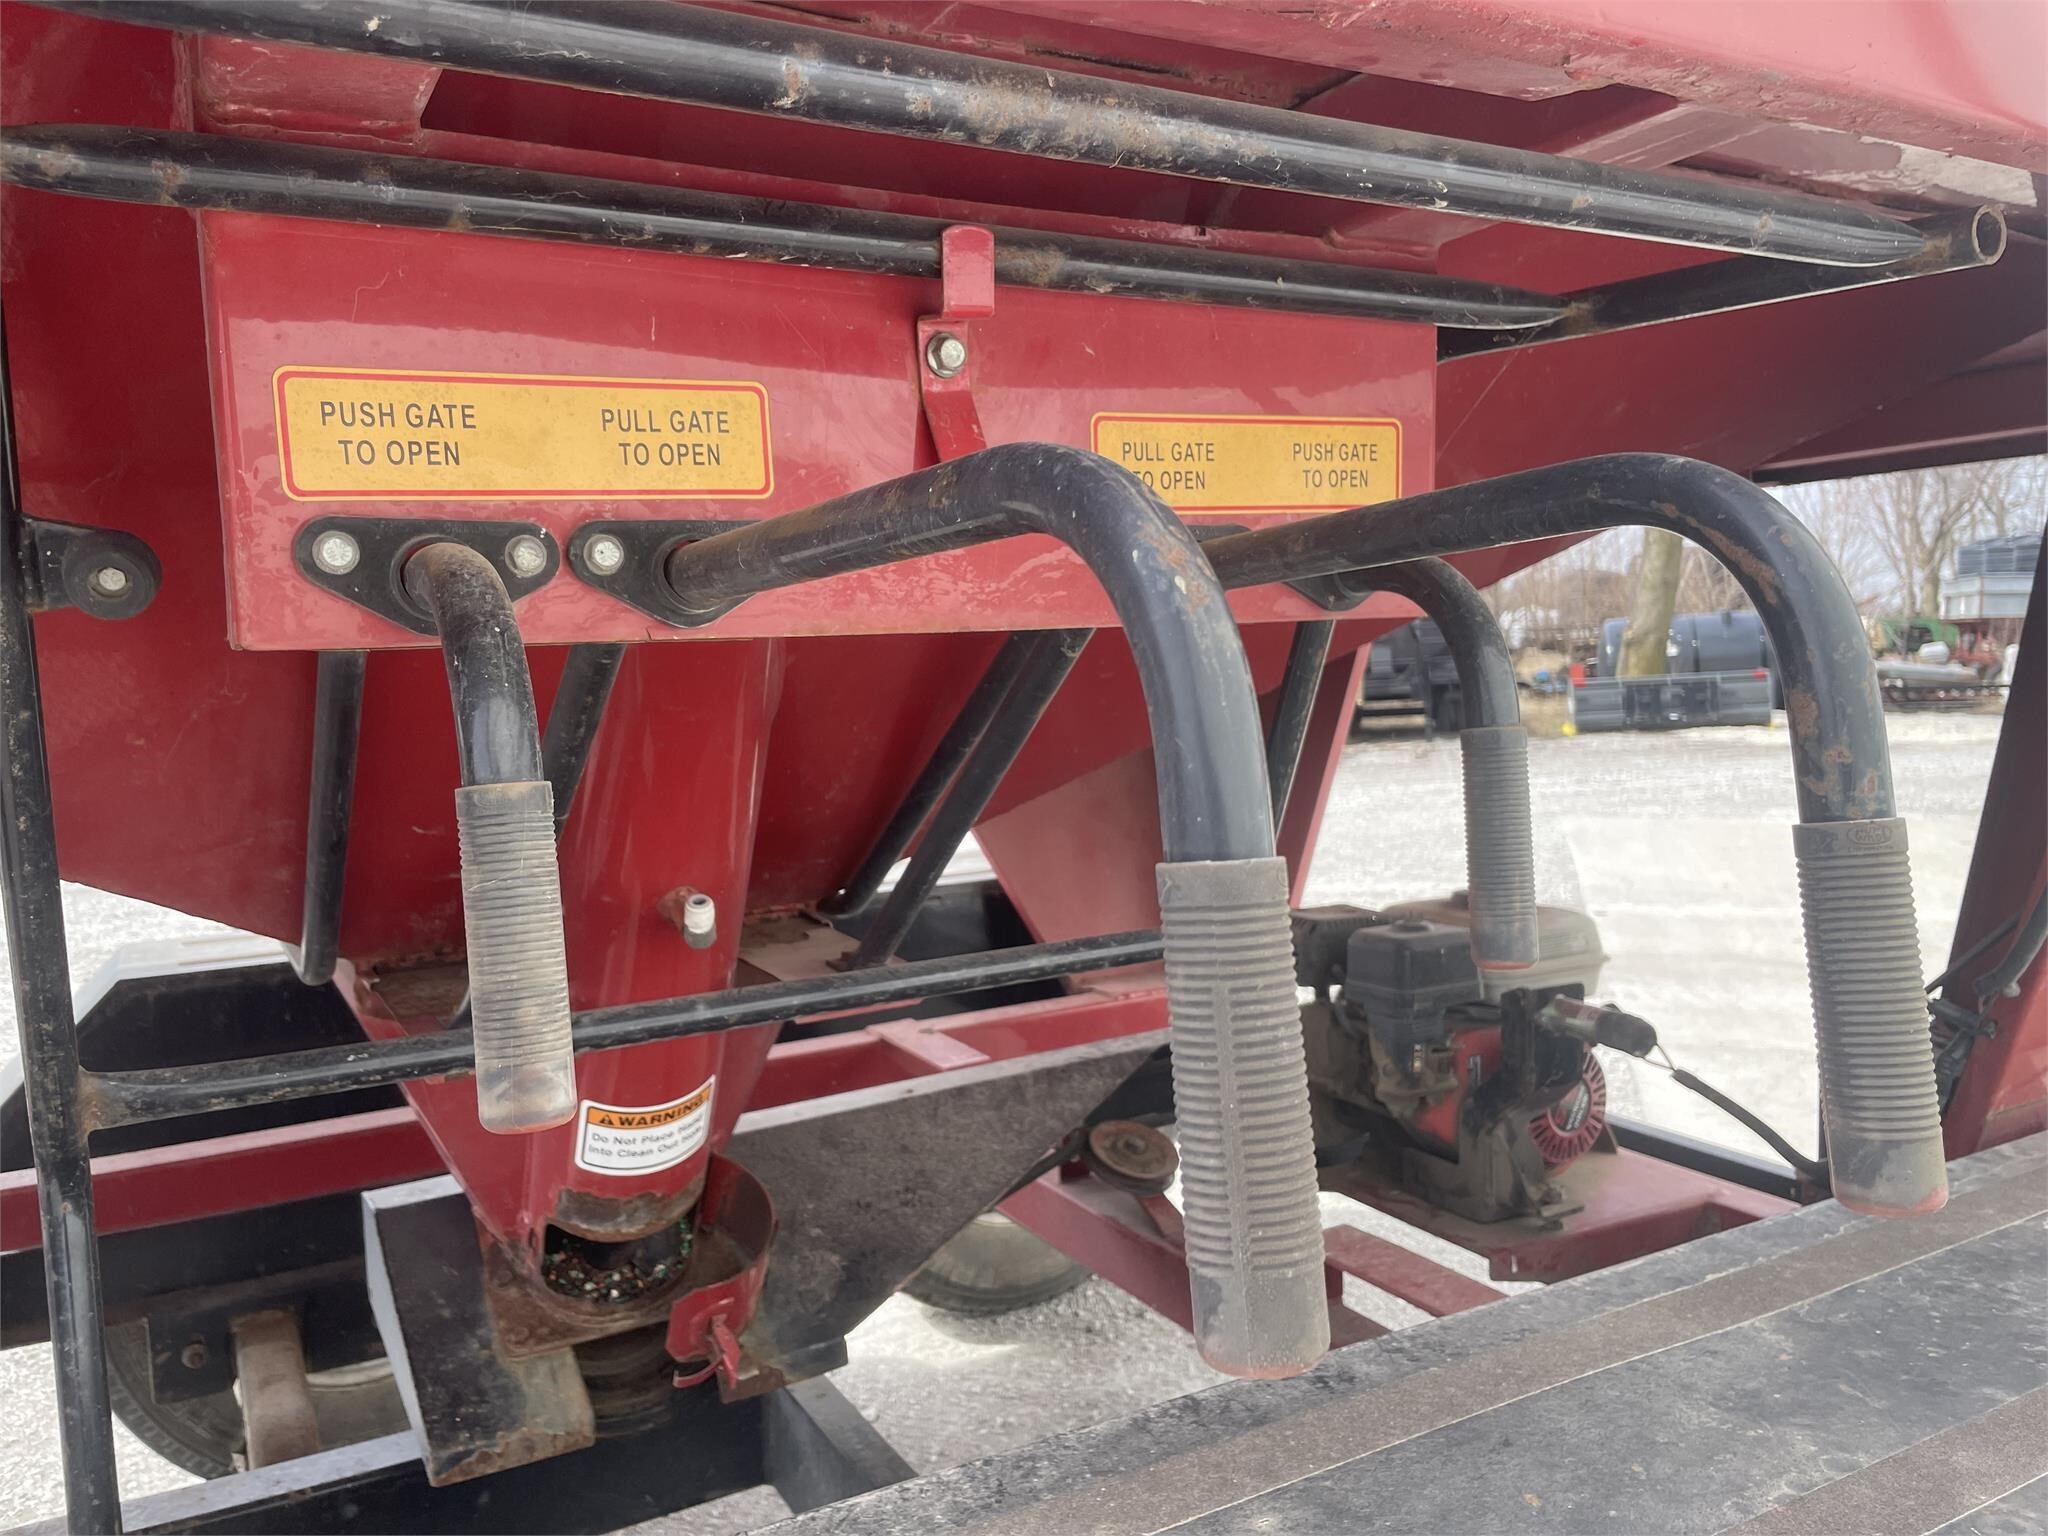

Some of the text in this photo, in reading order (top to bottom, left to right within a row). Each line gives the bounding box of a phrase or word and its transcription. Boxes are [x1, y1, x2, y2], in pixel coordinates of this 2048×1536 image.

[320, 401, 477, 430] PUSH GATE
[601, 409, 729, 434] PULL GATE
[338, 440, 460, 467] TO OPEN
[618, 443, 721, 467] TO OPEN
[1122, 442, 1215, 462] PULL GATE
[1293, 443, 1379, 462] PUSH GATE
[1160, 471, 1205, 490] OPEN
[1303, 470, 1369, 488] TO OPEN
[619, 1095, 703, 1126] WARNING
[592, 1132, 609, 1144] Do
[613, 1134, 636, 1145] Not
